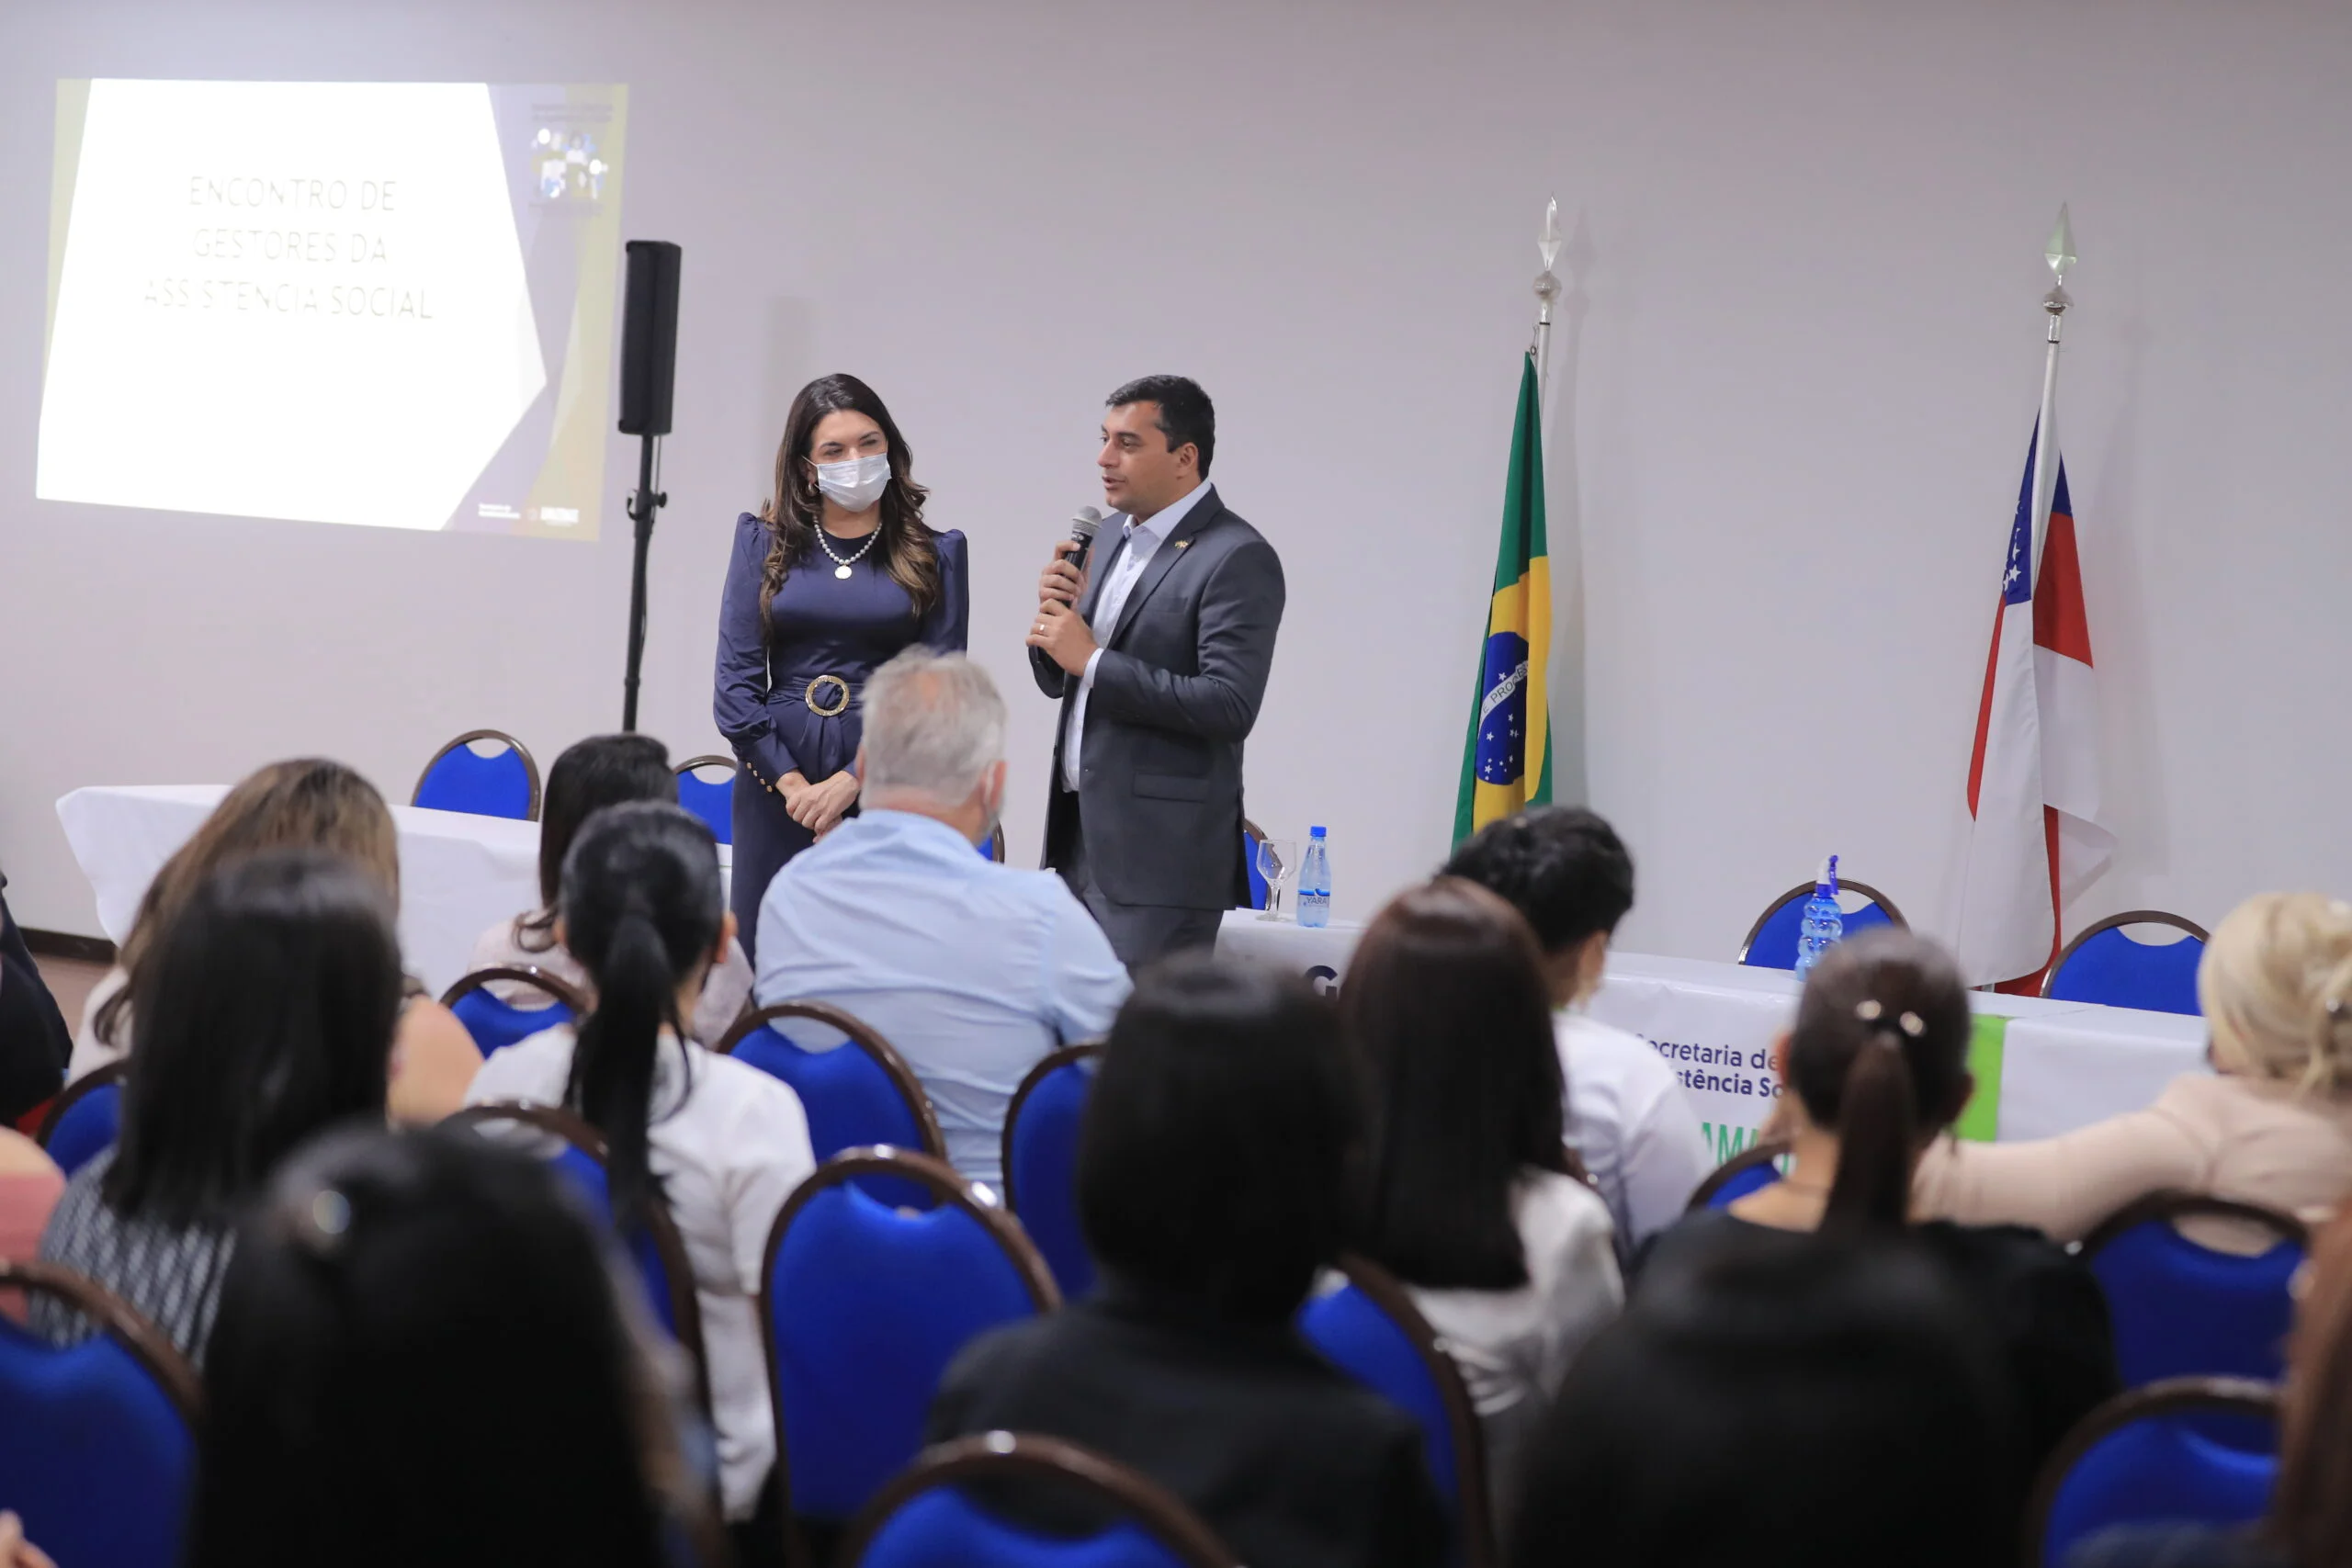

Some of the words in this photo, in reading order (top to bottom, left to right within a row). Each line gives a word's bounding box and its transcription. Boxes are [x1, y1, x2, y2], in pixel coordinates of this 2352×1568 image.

[189, 175, 346, 209] ENCONTRO
[361, 180, 397, 211] DE
[194, 228, 335, 262] GESTORES
[351, 233, 387, 263] DA
[144, 277, 317, 312] ASSSTENCIA
[331, 286, 433, 319] SOCIAL
[1636, 1033, 1743, 1067] cretaria
